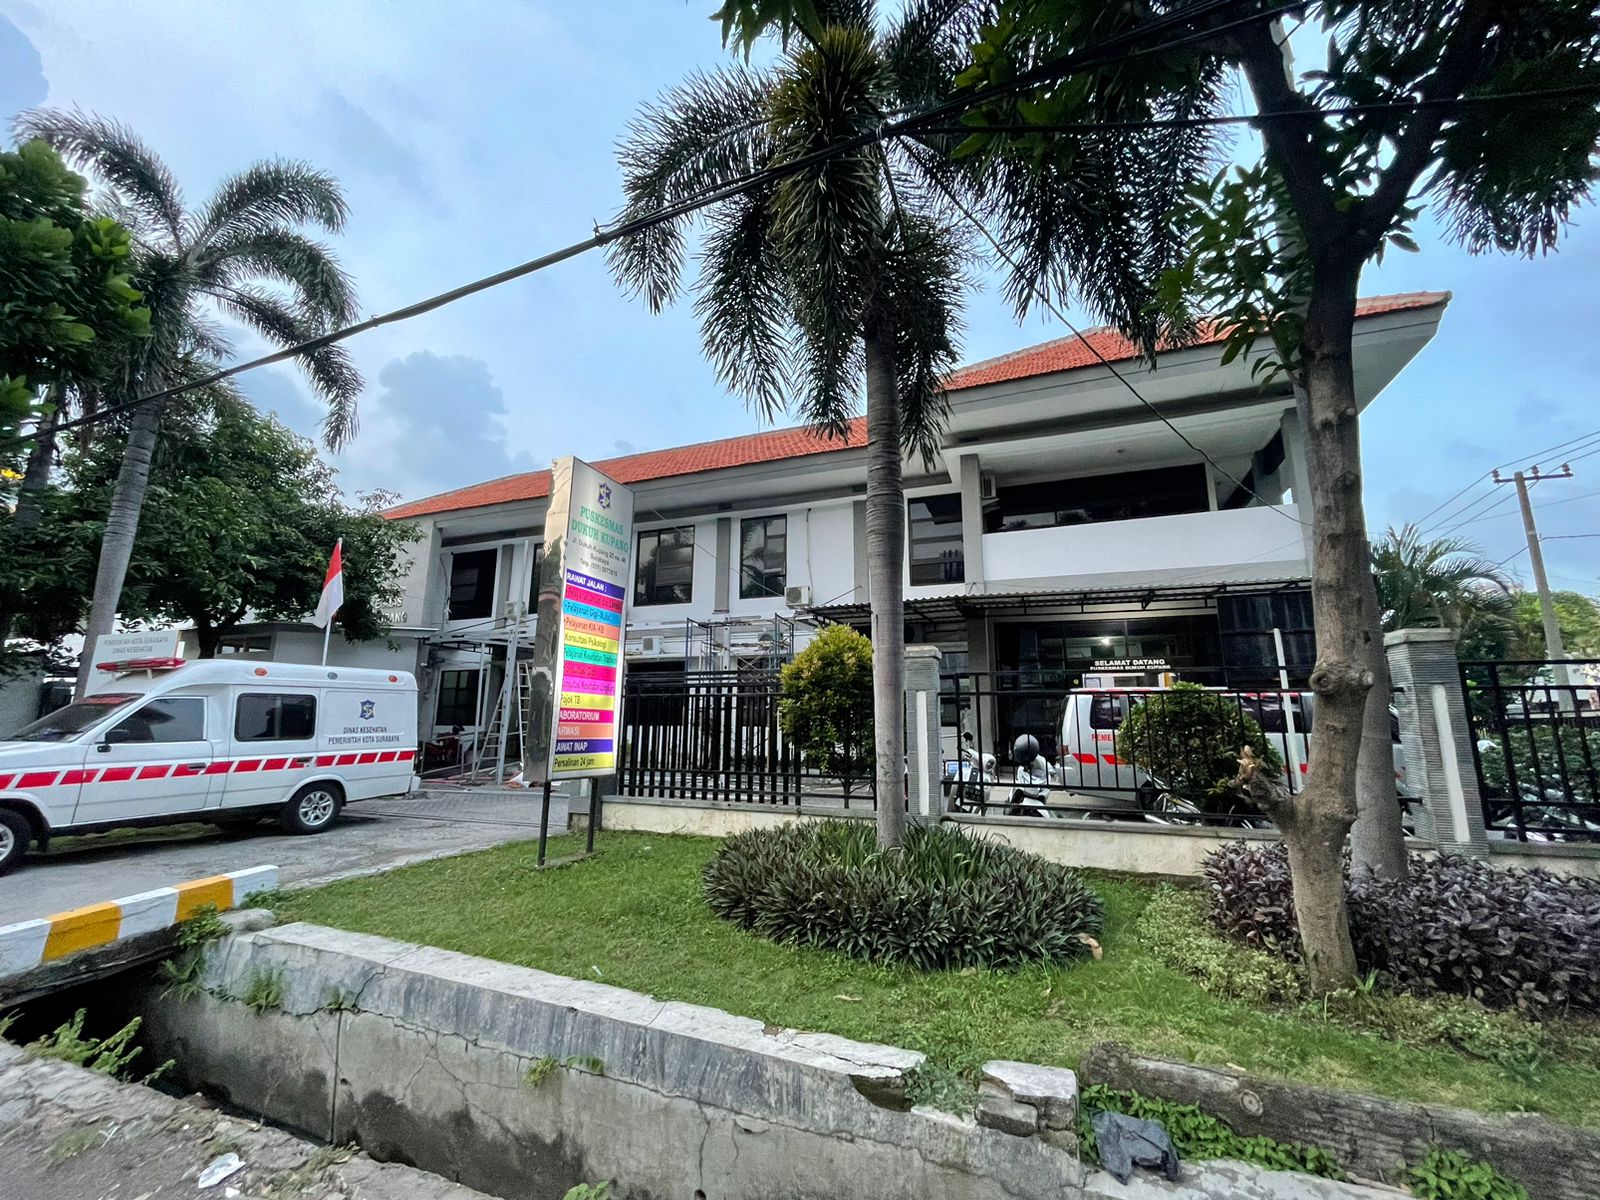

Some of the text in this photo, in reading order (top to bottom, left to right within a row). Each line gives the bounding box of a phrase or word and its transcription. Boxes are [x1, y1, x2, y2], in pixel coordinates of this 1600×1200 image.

[580, 506, 624, 536] PUSKESMAS
[572, 520, 629, 553] DUKUH KUPANG
[590, 552, 610, 566] Surabaya
[567, 572, 586, 586] RAWAT
[587, 579, 604, 592] JALAN
[567, 602, 588, 616] Pelayanan
[566, 617, 588, 630] Pelayanan
[561, 694, 580, 706] Pojok TB
[560, 711, 600, 721] ABORATORIUM
[344, 726, 387, 734] DINAS KESEHATAN
[558, 726, 580, 736] ARMASI
[328, 736, 362, 744] PEMERINTAH
[556, 742, 588, 752] AWAT INAP
[555, 758, 579, 768] Persalinan
